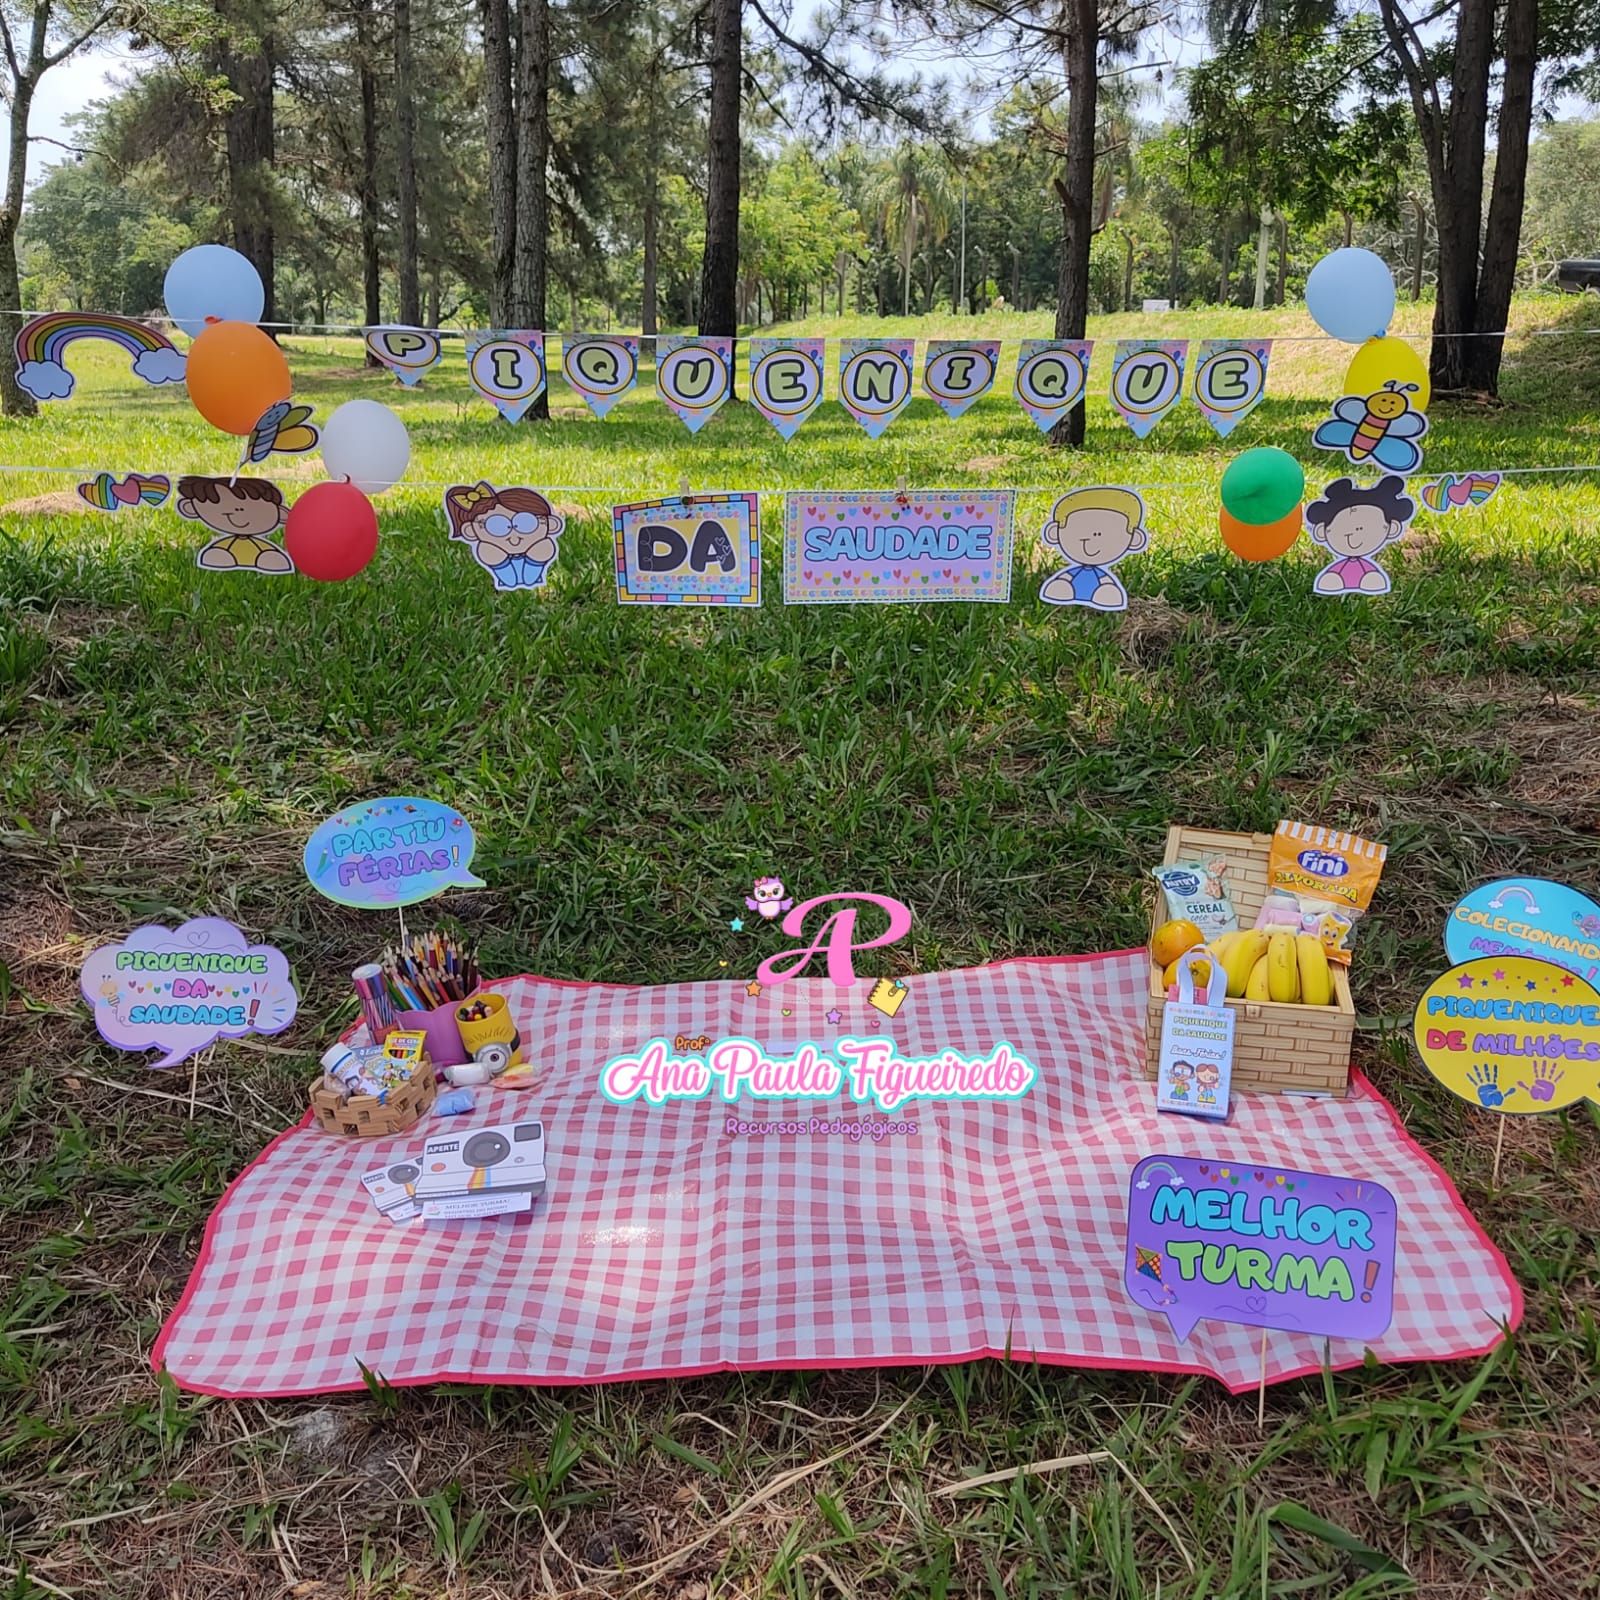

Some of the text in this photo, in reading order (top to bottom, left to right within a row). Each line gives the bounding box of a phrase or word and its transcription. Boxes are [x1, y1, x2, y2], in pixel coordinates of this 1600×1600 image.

[636, 519, 737, 574] DA
[804, 525, 993, 562] SAUDADE
[331, 816, 446, 858] PARTIU
[1164, 876, 1196, 889] NUTRY
[1186, 903, 1226, 914] CEREAL
[1454, 907, 1600, 961] COLECIONAND
[116, 951, 268, 974] PIQUENIQUE
[172, 978, 209, 998] DA
[1173, 1015, 1227, 1029] PIQUENIQUE
[1427, 996, 1600, 1026] PIQUENIQUE
[1187, 1030, 1227, 1041] SAUDADE
[1426, 1029, 1600, 1063] DE MILHÕES
[427, 1142, 459, 1153] APERTE
[1150, 1184, 1375, 1251] MELHOR
